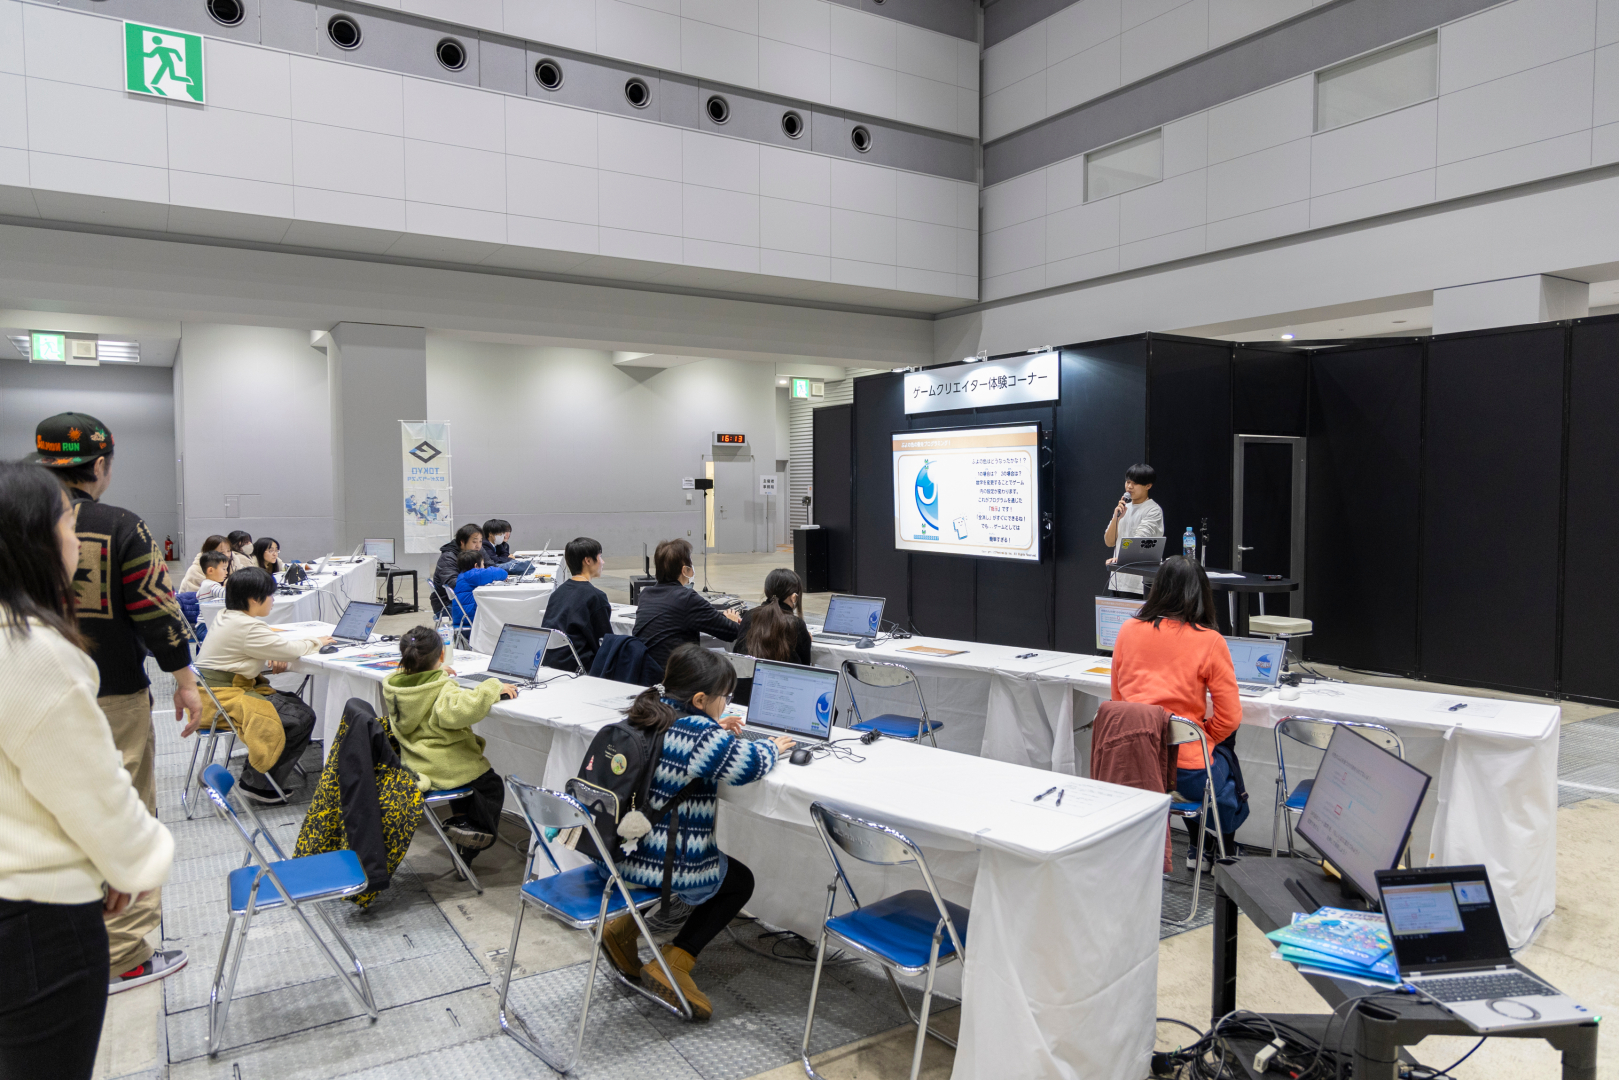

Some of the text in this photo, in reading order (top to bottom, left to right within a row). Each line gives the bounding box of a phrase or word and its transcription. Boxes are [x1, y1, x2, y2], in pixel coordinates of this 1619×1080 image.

[913, 372, 1048, 398] ゲームクリエイター体験コーナー
[721, 435, 743, 443] 16:13
[62, 442, 80, 452] RUN
